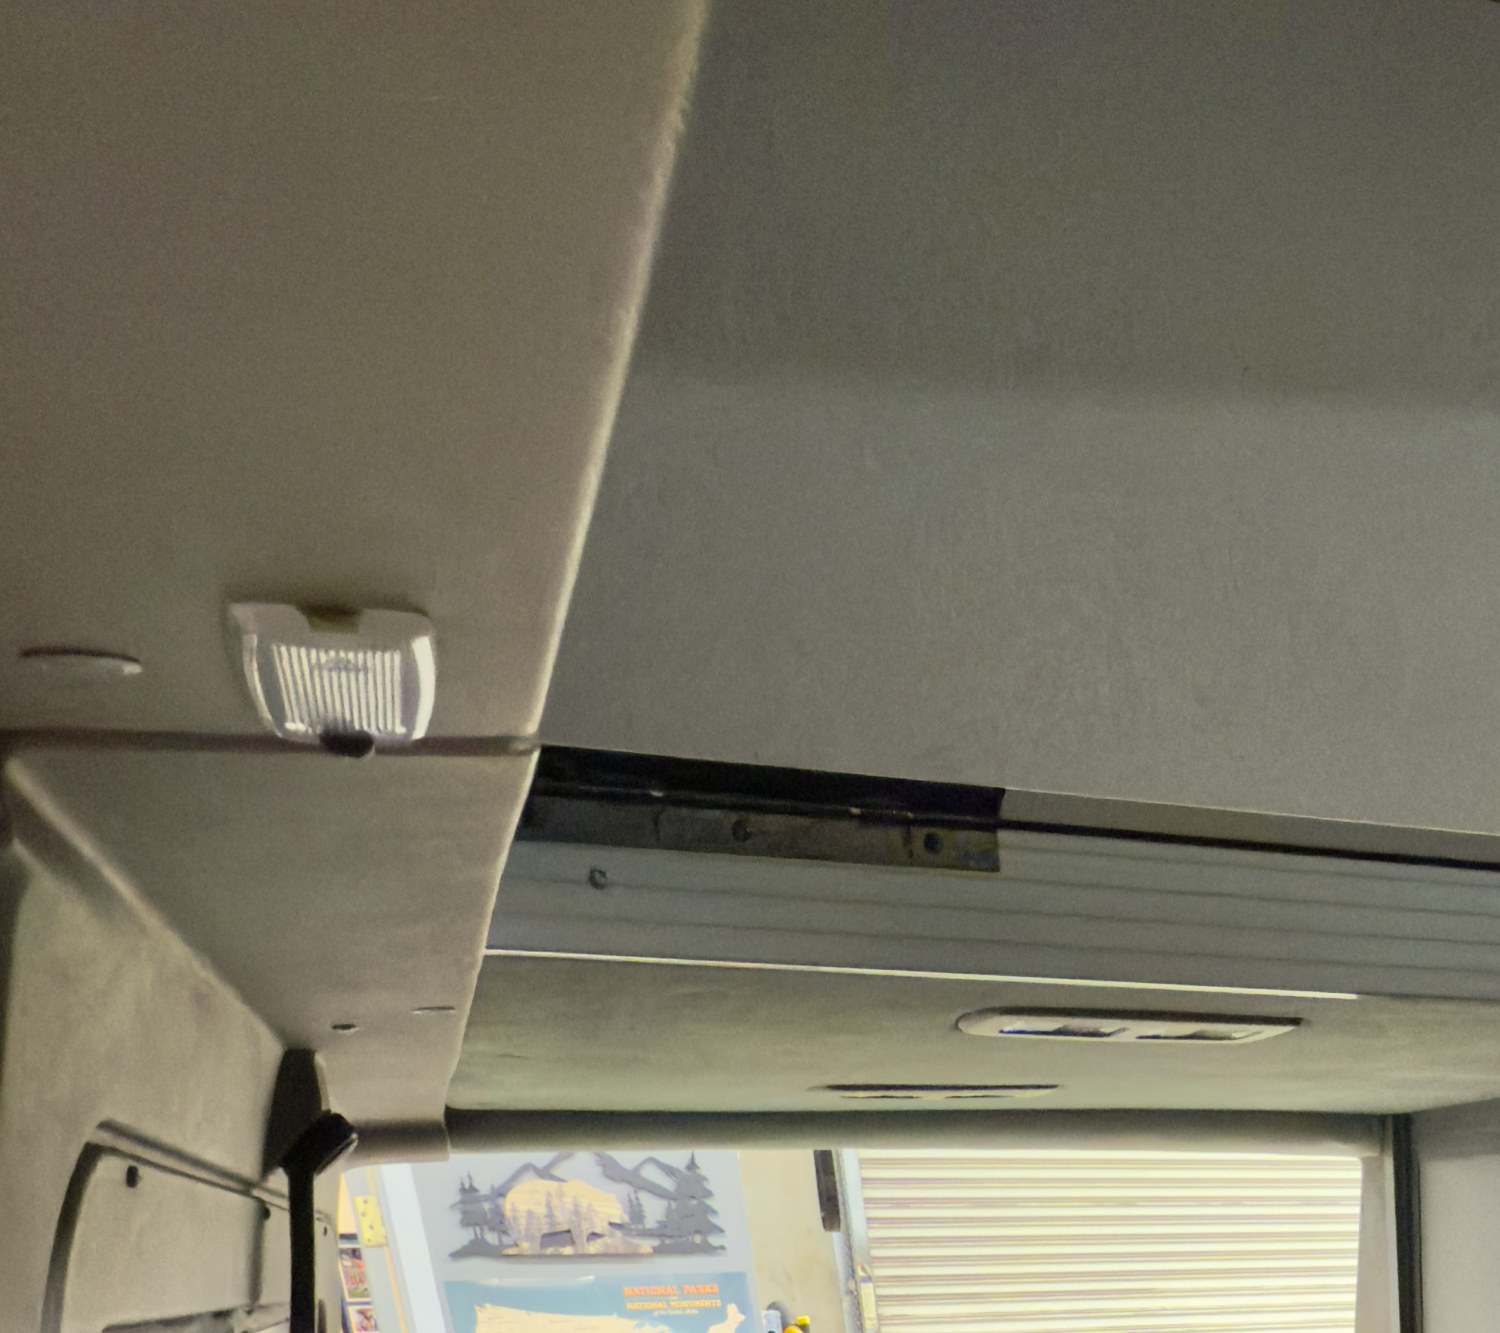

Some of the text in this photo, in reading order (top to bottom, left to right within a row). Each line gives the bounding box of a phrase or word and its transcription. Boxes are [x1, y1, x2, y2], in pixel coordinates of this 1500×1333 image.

[623, 1283, 719, 1296] NATIONAL PARKS
[625, 1299, 722, 1311] NATIONAL MONUMENTS
